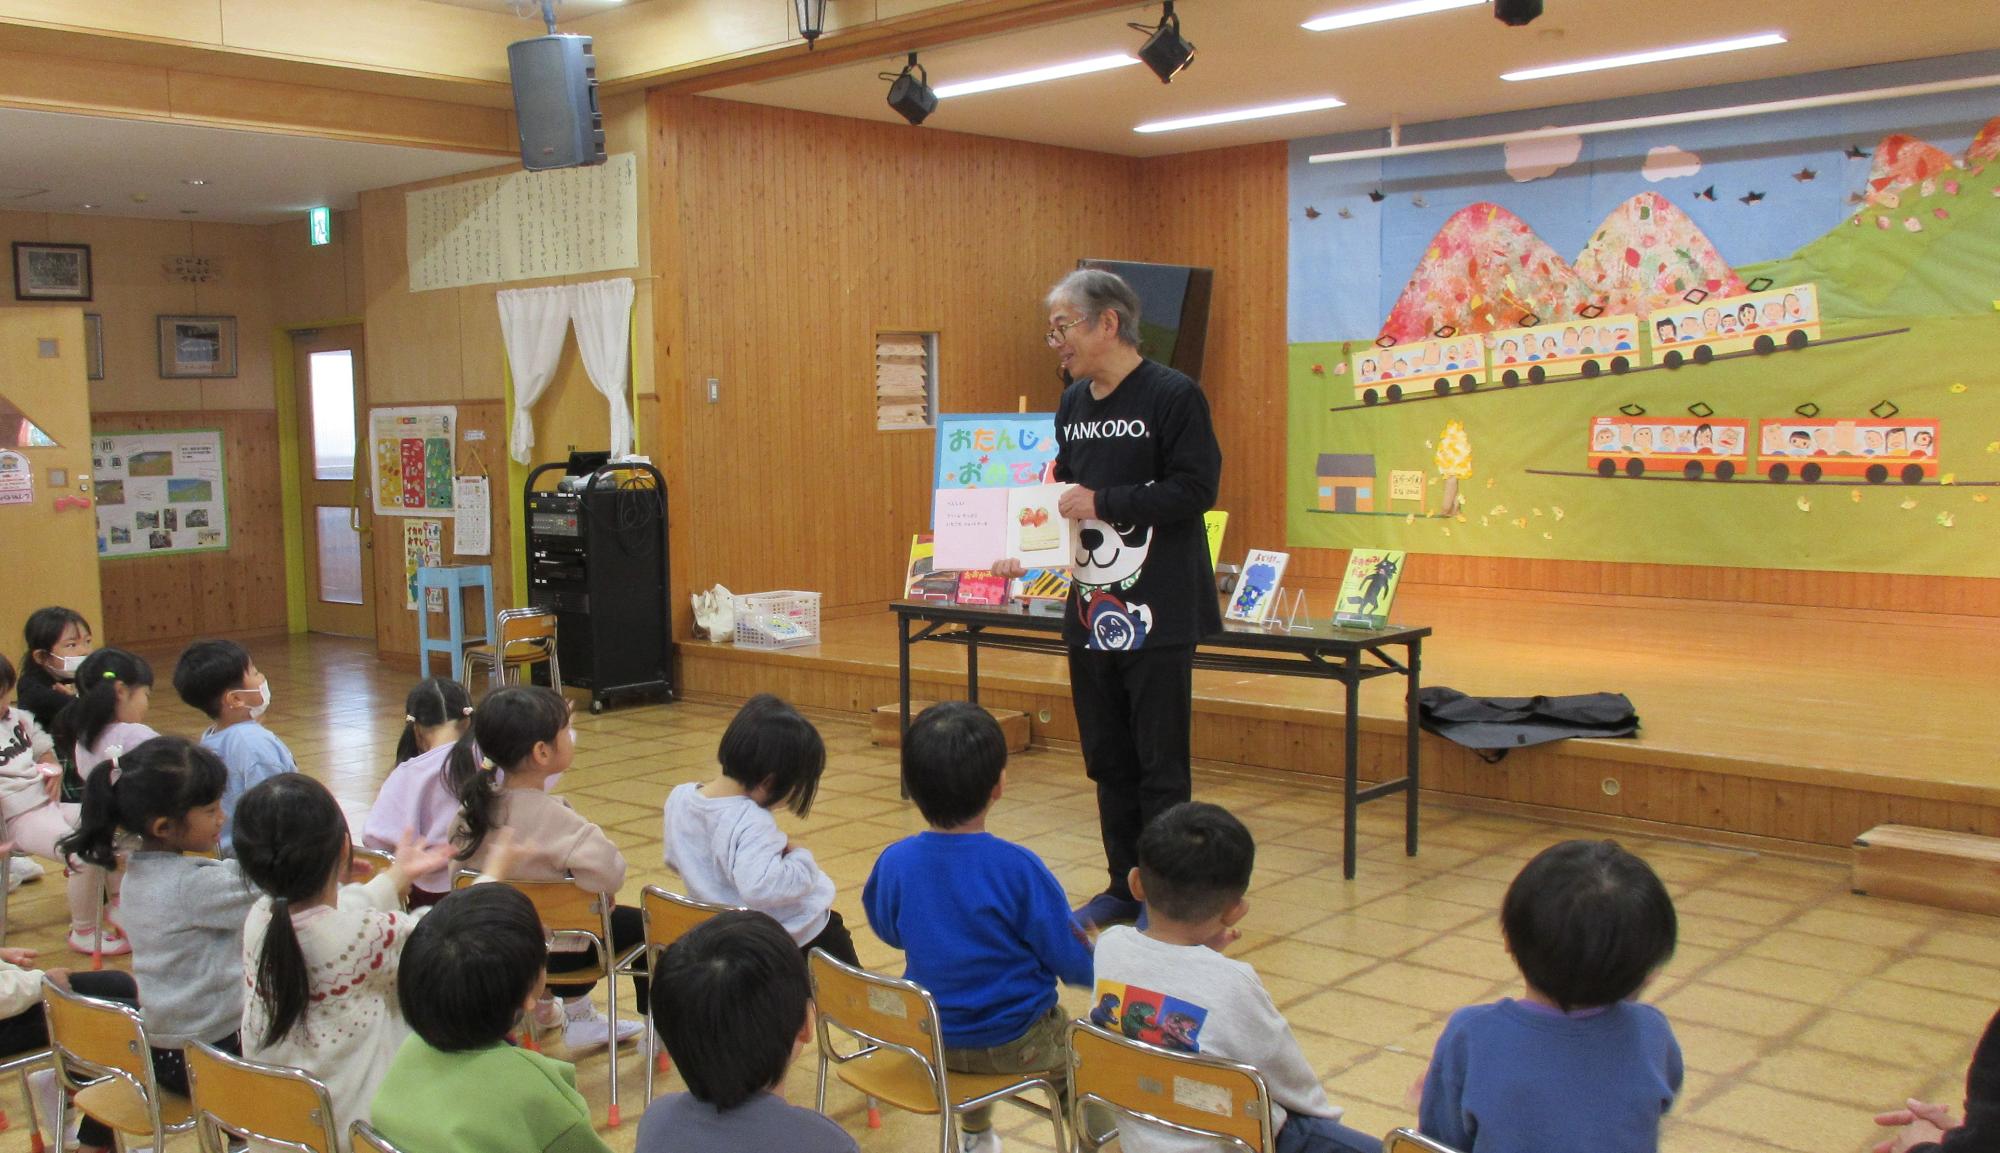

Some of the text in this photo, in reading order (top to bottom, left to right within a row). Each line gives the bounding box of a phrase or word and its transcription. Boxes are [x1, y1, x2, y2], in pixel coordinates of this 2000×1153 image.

[948, 428, 1059, 453] おたんじょ
